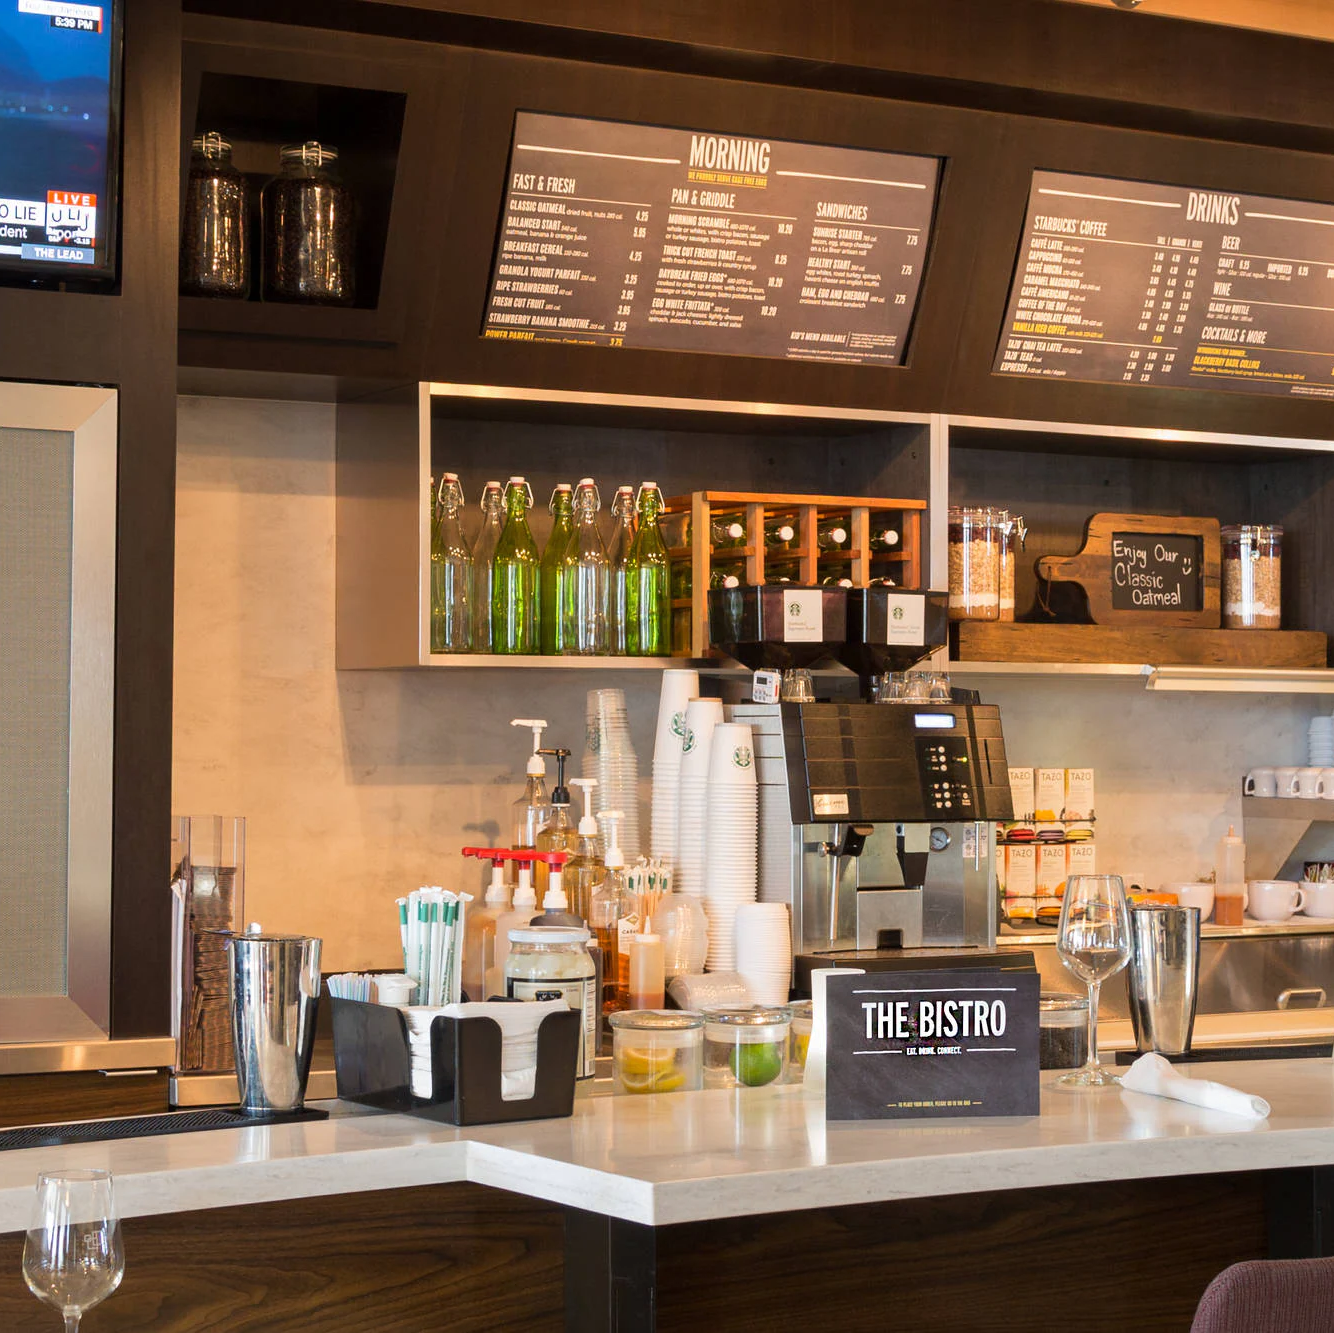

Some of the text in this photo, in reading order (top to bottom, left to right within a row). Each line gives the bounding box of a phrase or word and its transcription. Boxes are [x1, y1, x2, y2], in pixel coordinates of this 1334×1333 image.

[78, 20, 93, 30] PM
[689, 135, 770, 173] MORNING
[513, 173, 576, 194] FAST & FRESH
[54, 193, 90, 206] LIVE
[671, 188, 735, 209] PAN & GRIDDLE
[15, 205, 36, 221] LIE
[510, 200, 537, 213] CLASSIC
[538, 202, 566, 215] OATMEAL
[816, 202, 868, 221] SANDWICHES
[1186, 192, 1240, 226] DRINKS
[508, 216, 540, 229] BALANCED
[542, 219, 561, 230] START
[667, 213, 697, 225] MORNING
[698, 216, 730, 229] SCRAMBLE
[1080, 220, 1107, 236] COFFEE
[813, 227, 838, 238] SUNRISE
[838, 229, 863, 240] STARTER
[504, 240, 539, 253] BREAKFAST
[540, 243, 563, 256] CEREAL
[1048, 240, 1063, 250] LATTE
[1222, 235, 1241, 250] BEER
[34, 247, 83, 260] THE LEAD
[663, 245, 682, 255] THICK
[682, 246, 694, 256] CUT
[694, 247, 717, 259] FRENCH
[718, 250, 737, 260] TOAST
[807, 257, 833, 269] HEALTHY
[833, 259, 851, 270] START
[499, 264, 528, 277] GRANOLA
[529, 267, 554, 279] YOGURT
[555, 269, 581, 280] PARFAIT
[658, 268, 691, 280] DAYBREAK
[691, 270, 708, 282] FRIED
[496, 280, 511, 292] RIPE
[512, 281, 559, 295] STRAWBERRIES
[830, 289, 843, 300] AND
[1213, 281, 1233, 296] WINE
[492, 296, 513, 308] FRESH
[514, 298, 526, 309] CUT
[527, 299, 545, 310] FRUIT
[652, 298, 664, 308] EGG
[665, 299, 684, 309] WHITE
[1018, 298, 1038, 309] COFFEE
[489, 313, 530, 325] STRAWBERRY
[531, 315, 557, 327] BANANA
[558, 317, 590, 329] SMOOTHIE
[1201, 326, 1268, 344] COCKTAILS & MORE
[1000, 362, 1028, 372] ESPRESSO
[1113, 540, 1179, 568] Enjoy Our
[1115, 563, 1163, 589] Classic
[1133, 583, 1181, 605] Oatmeal
[1010, 772, 1030, 780] TAZO
[1042, 773, 1062, 781] TAZO
[1071, 772, 1091, 780] TAZO
[1011, 849, 1032, 857] TAZO
[1043, 849, 1063, 857] TAZO
[1072, 848, 1092, 856] TAZO
[861, 1000, 1006, 1039] THE BISTRO
